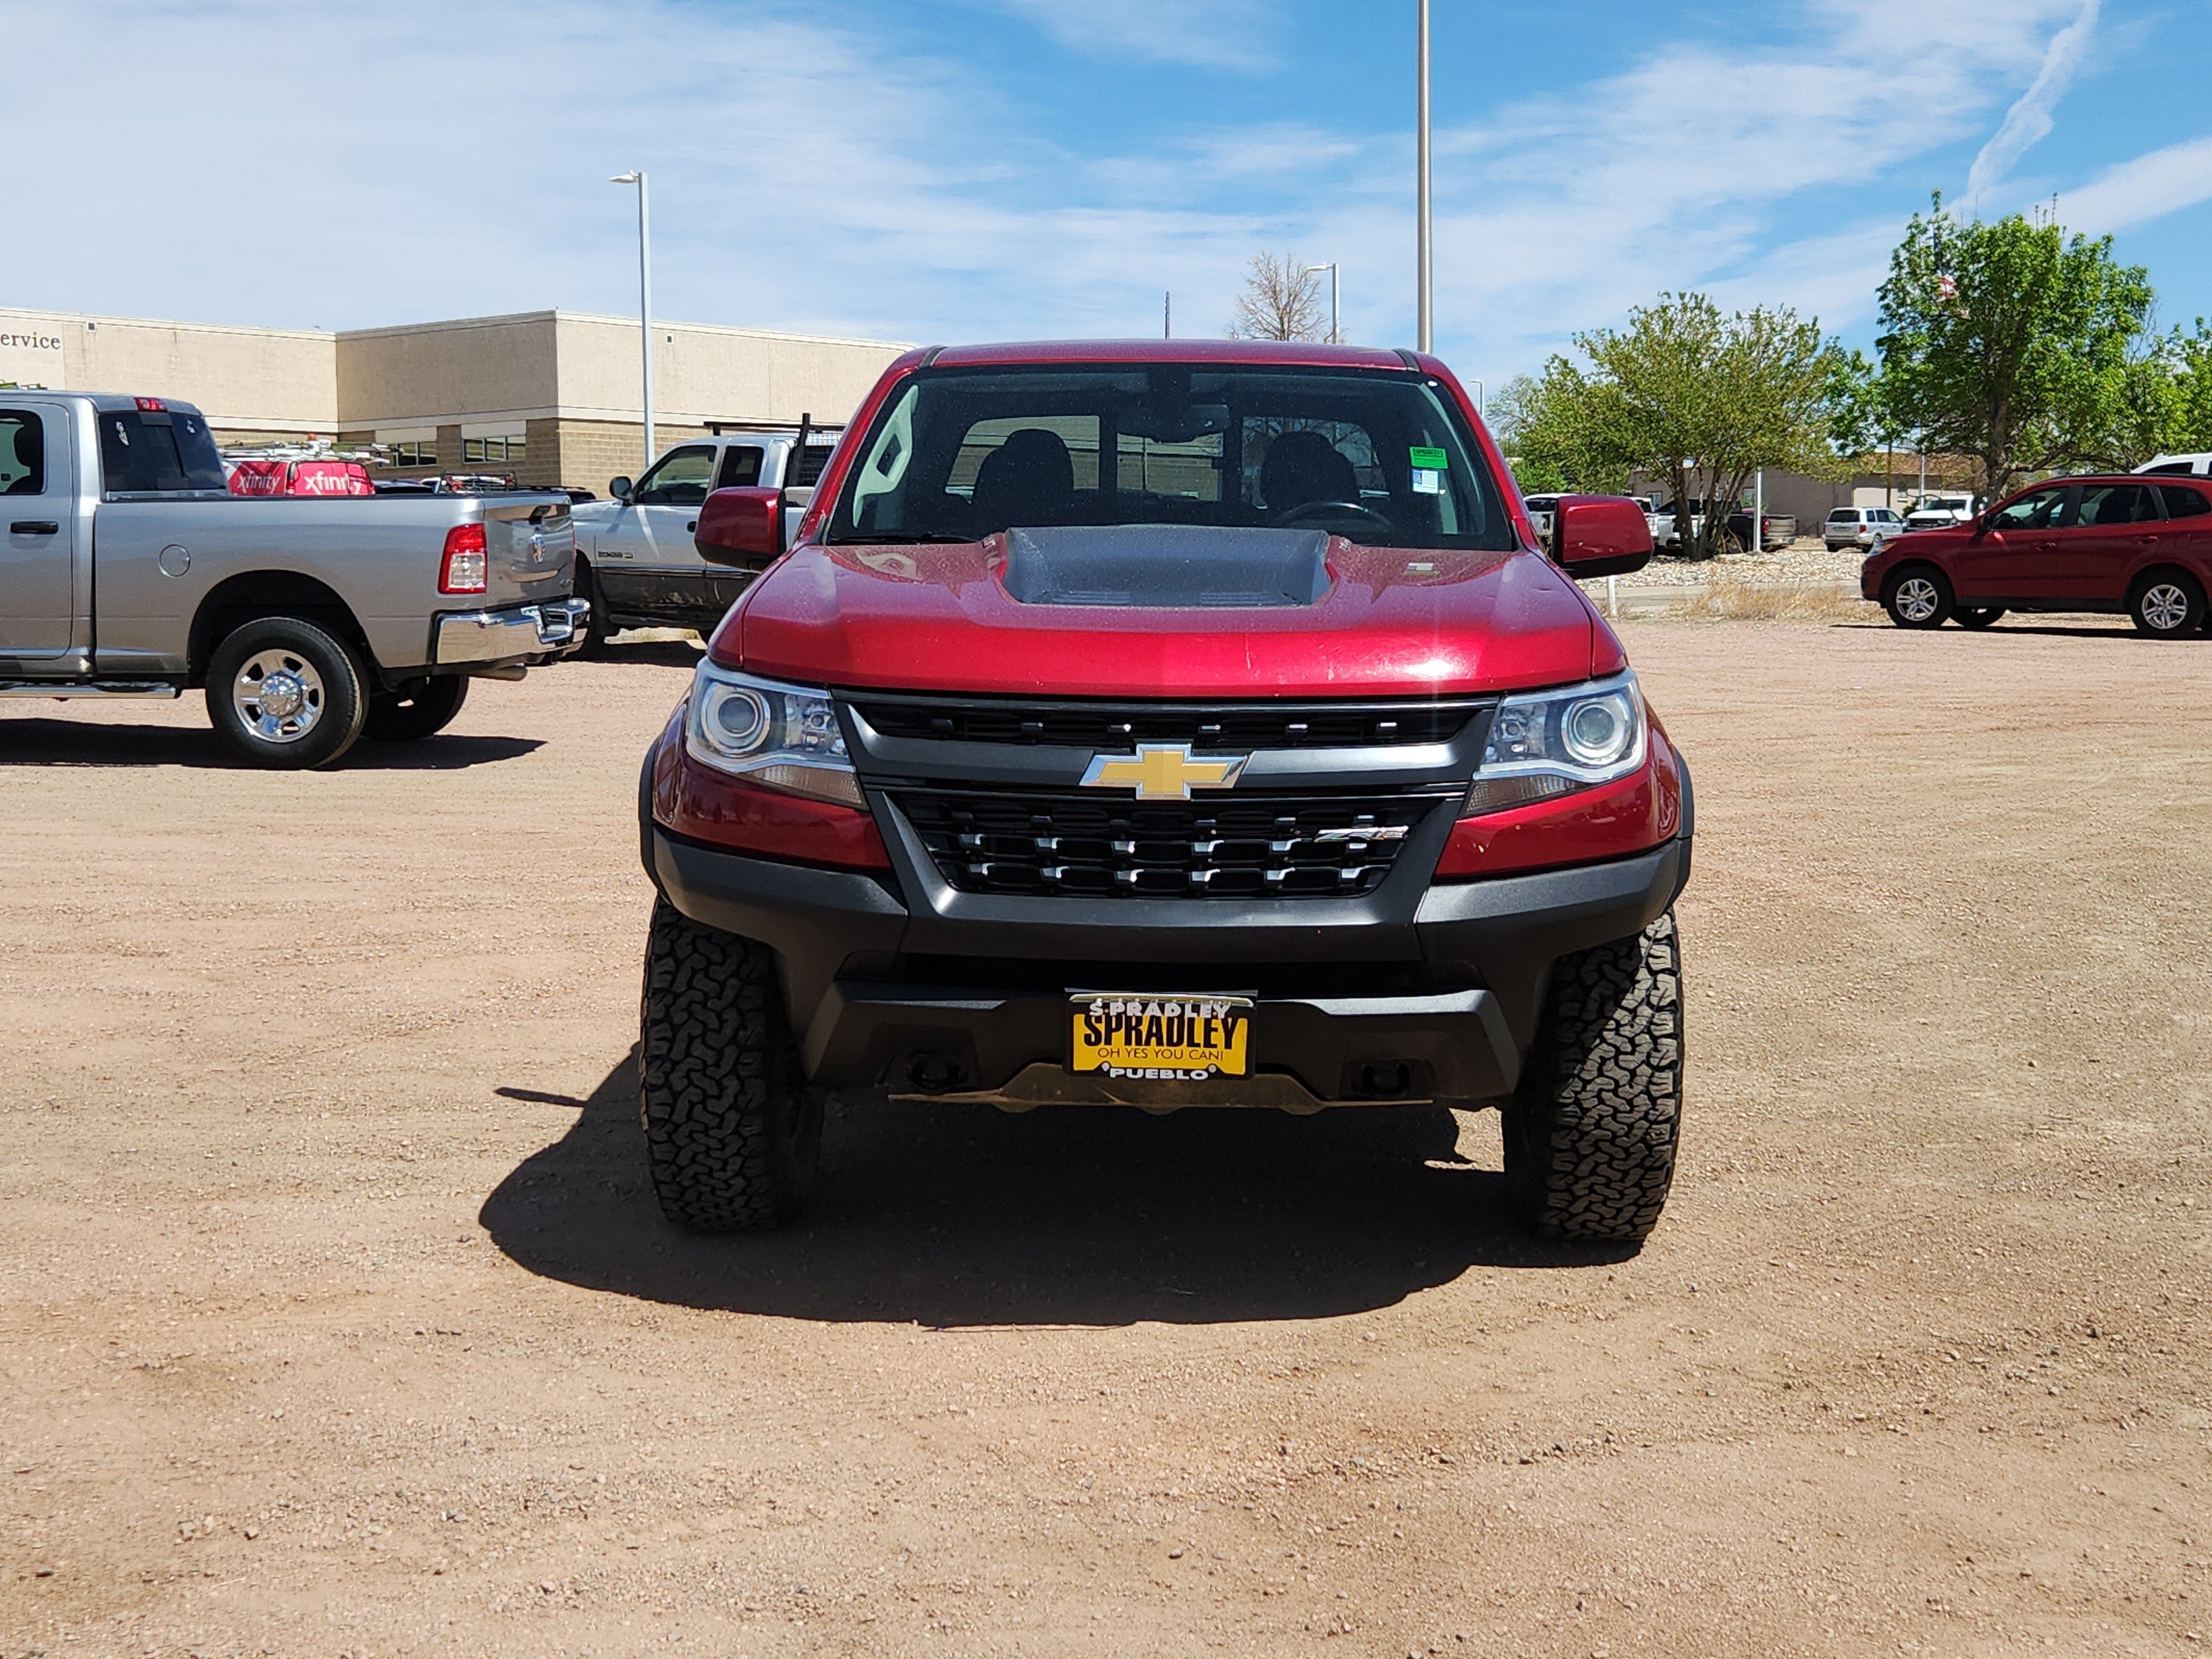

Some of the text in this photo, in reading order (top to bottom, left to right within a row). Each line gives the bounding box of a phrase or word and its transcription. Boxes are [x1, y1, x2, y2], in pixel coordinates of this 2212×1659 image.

[0, 331, 61, 350] ervice
[237, 470, 281, 494] xfinity
[1089, 1000, 1231, 1019] SPRADLEY
[1084, 1014, 1240, 1050] SPRADLEY
[1097, 1047, 1120, 1058] OH
[1125, 1047, 1148, 1058] YES
[1153, 1048, 1184, 1059] YOU
[1110, 1068, 1208, 1080] PUEBLO
